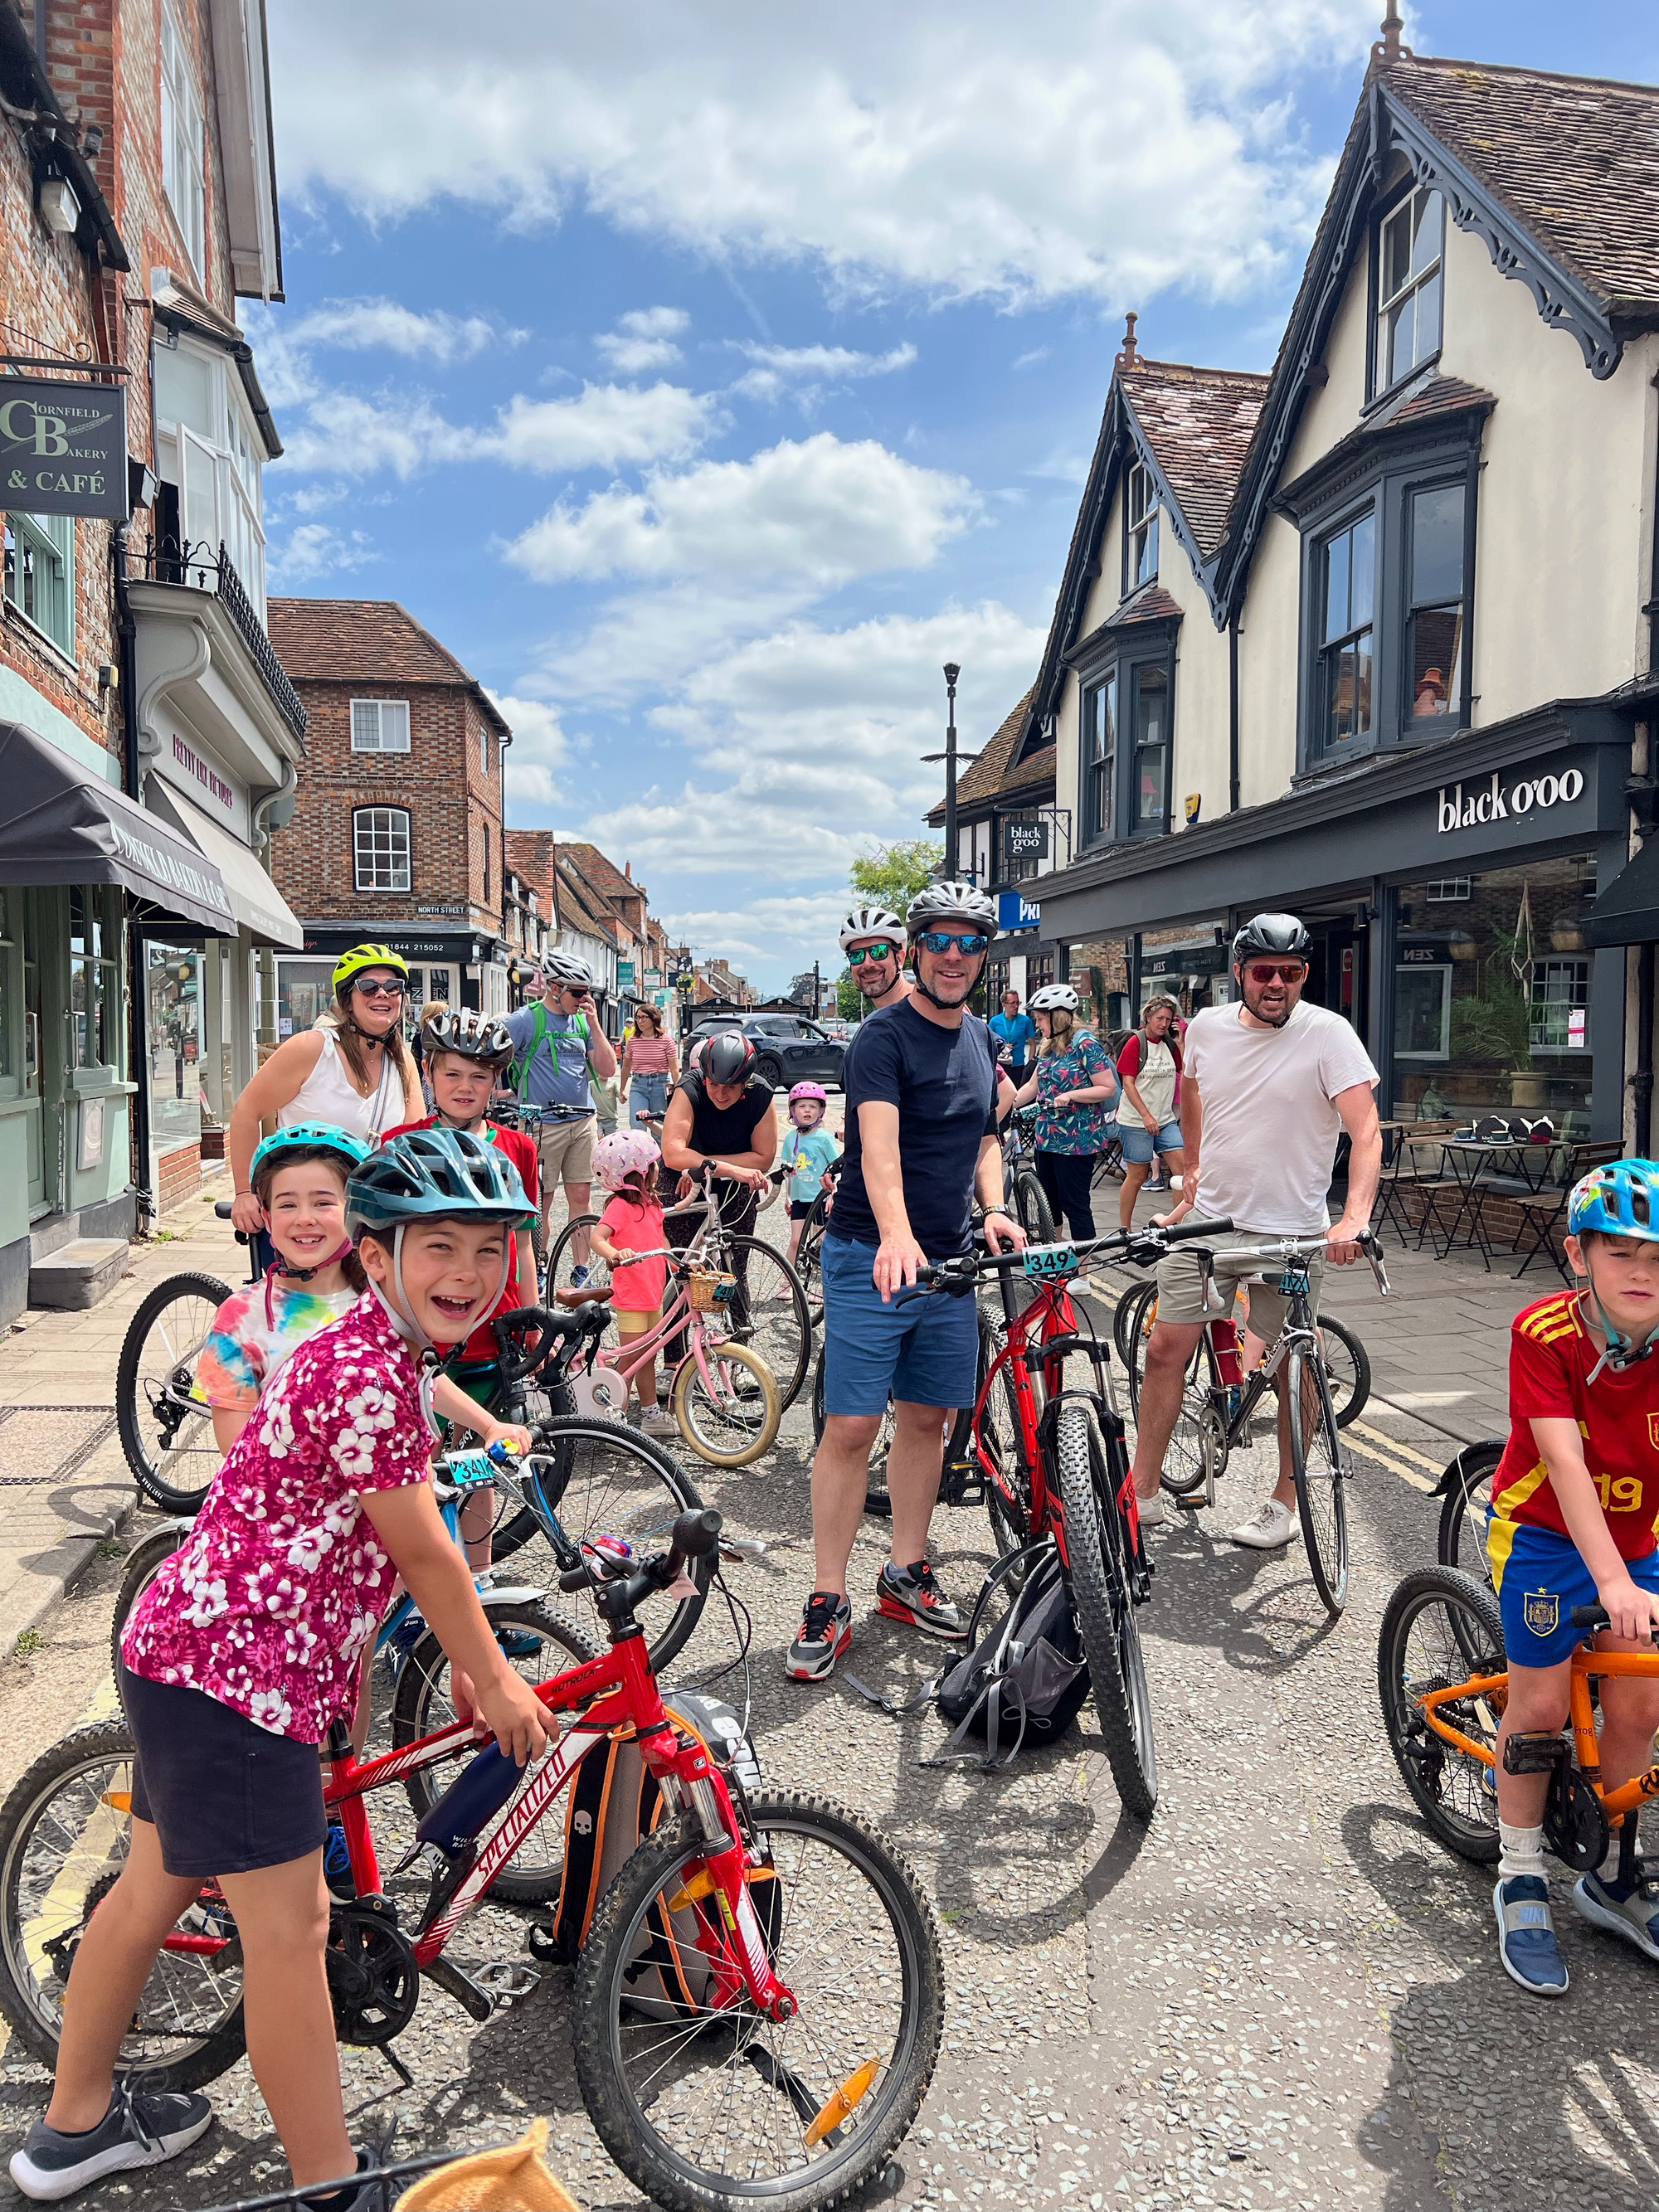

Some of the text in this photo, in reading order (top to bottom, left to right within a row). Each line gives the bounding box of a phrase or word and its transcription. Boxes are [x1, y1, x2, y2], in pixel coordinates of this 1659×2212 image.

[30, 415, 109, 459] BAKERY
[7, 469, 106, 495] & CAFÉ
[173, 733, 196, 775] PRETTY
[197, 757, 208, 788] LIKE
[1438, 773, 1510, 833] black
[1011, 826, 1042, 839] black
[1012, 839, 1040, 853] goo
[1030, 1251, 1068, 1272] 349
[1593, 1472, 1643, 1512] 19
[1574, 1725, 1593, 1737] Frog
[478, 1748, 567, 1884] SPECIALIZED
